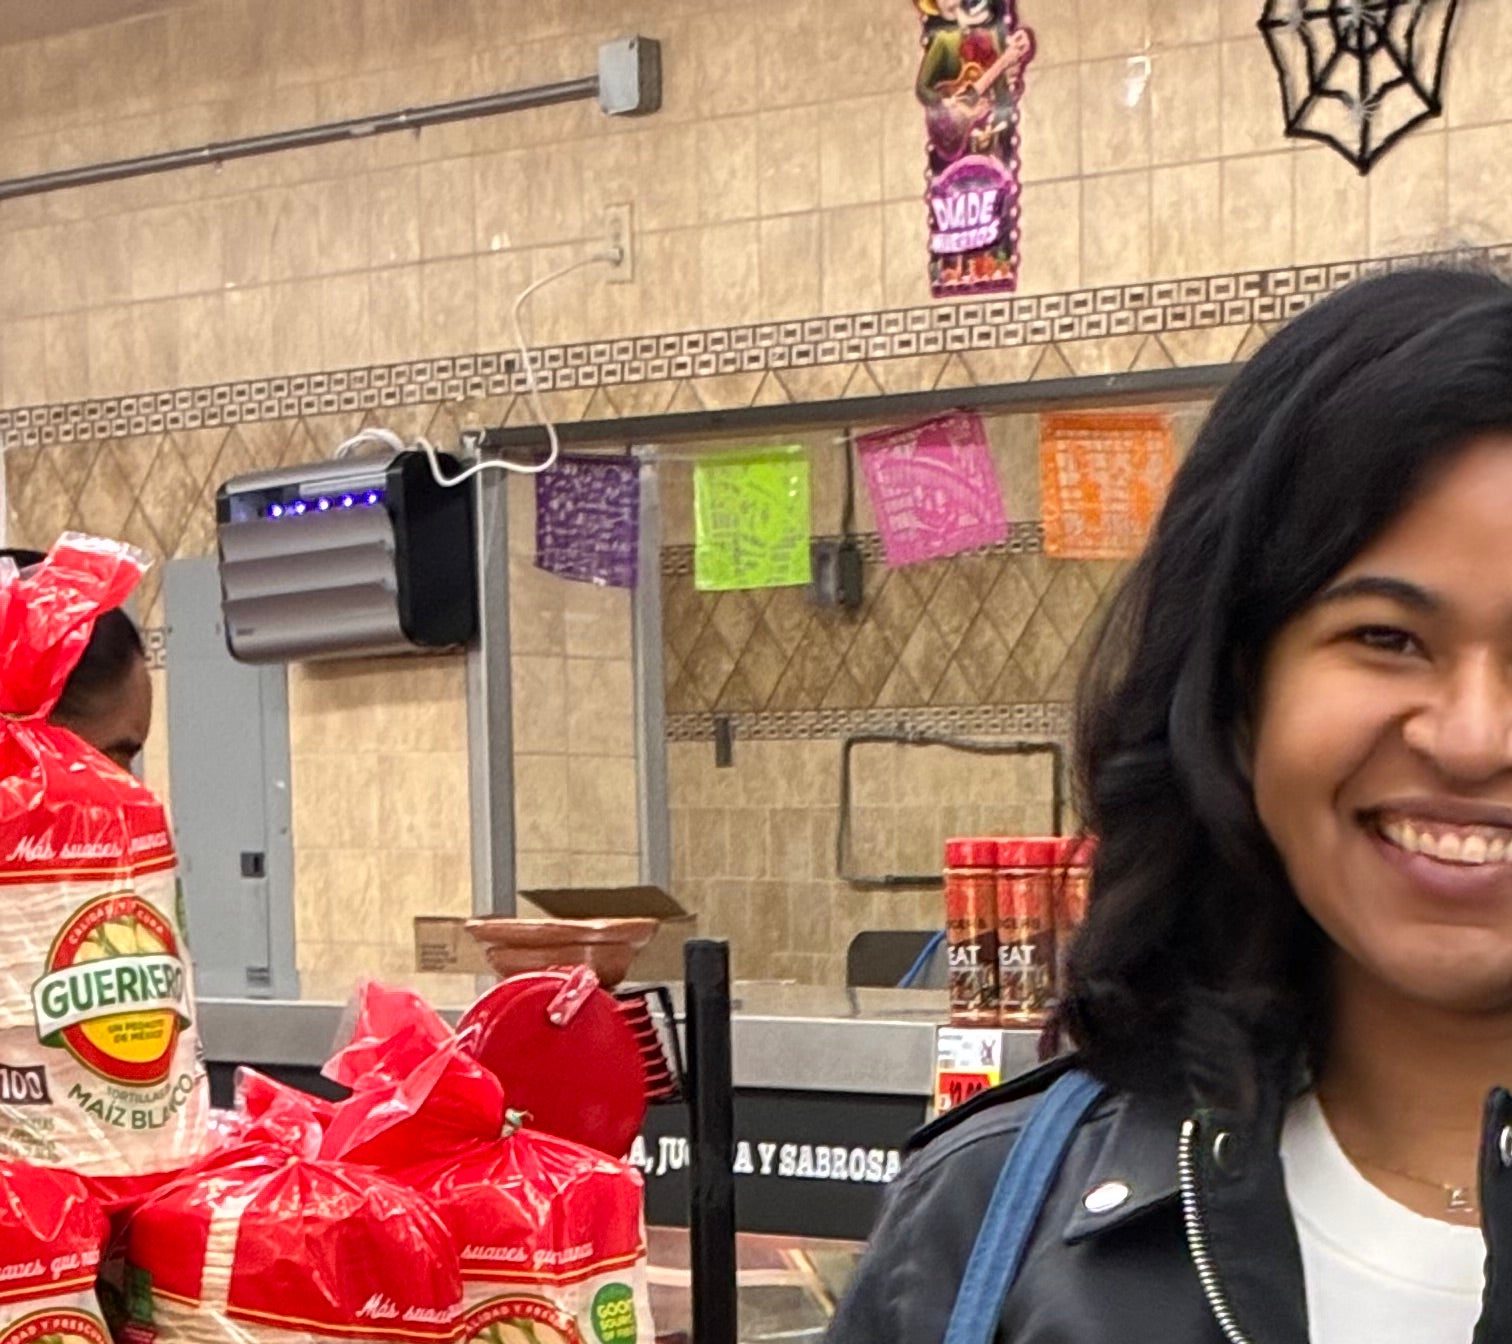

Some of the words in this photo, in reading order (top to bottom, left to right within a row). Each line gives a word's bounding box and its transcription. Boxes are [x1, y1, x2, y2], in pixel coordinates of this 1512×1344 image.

[931, 220, 998, 254] MUERTOS
[757, 1143, 777, 1175] Y
[778, 1144, 901, 1183] SABROSA
